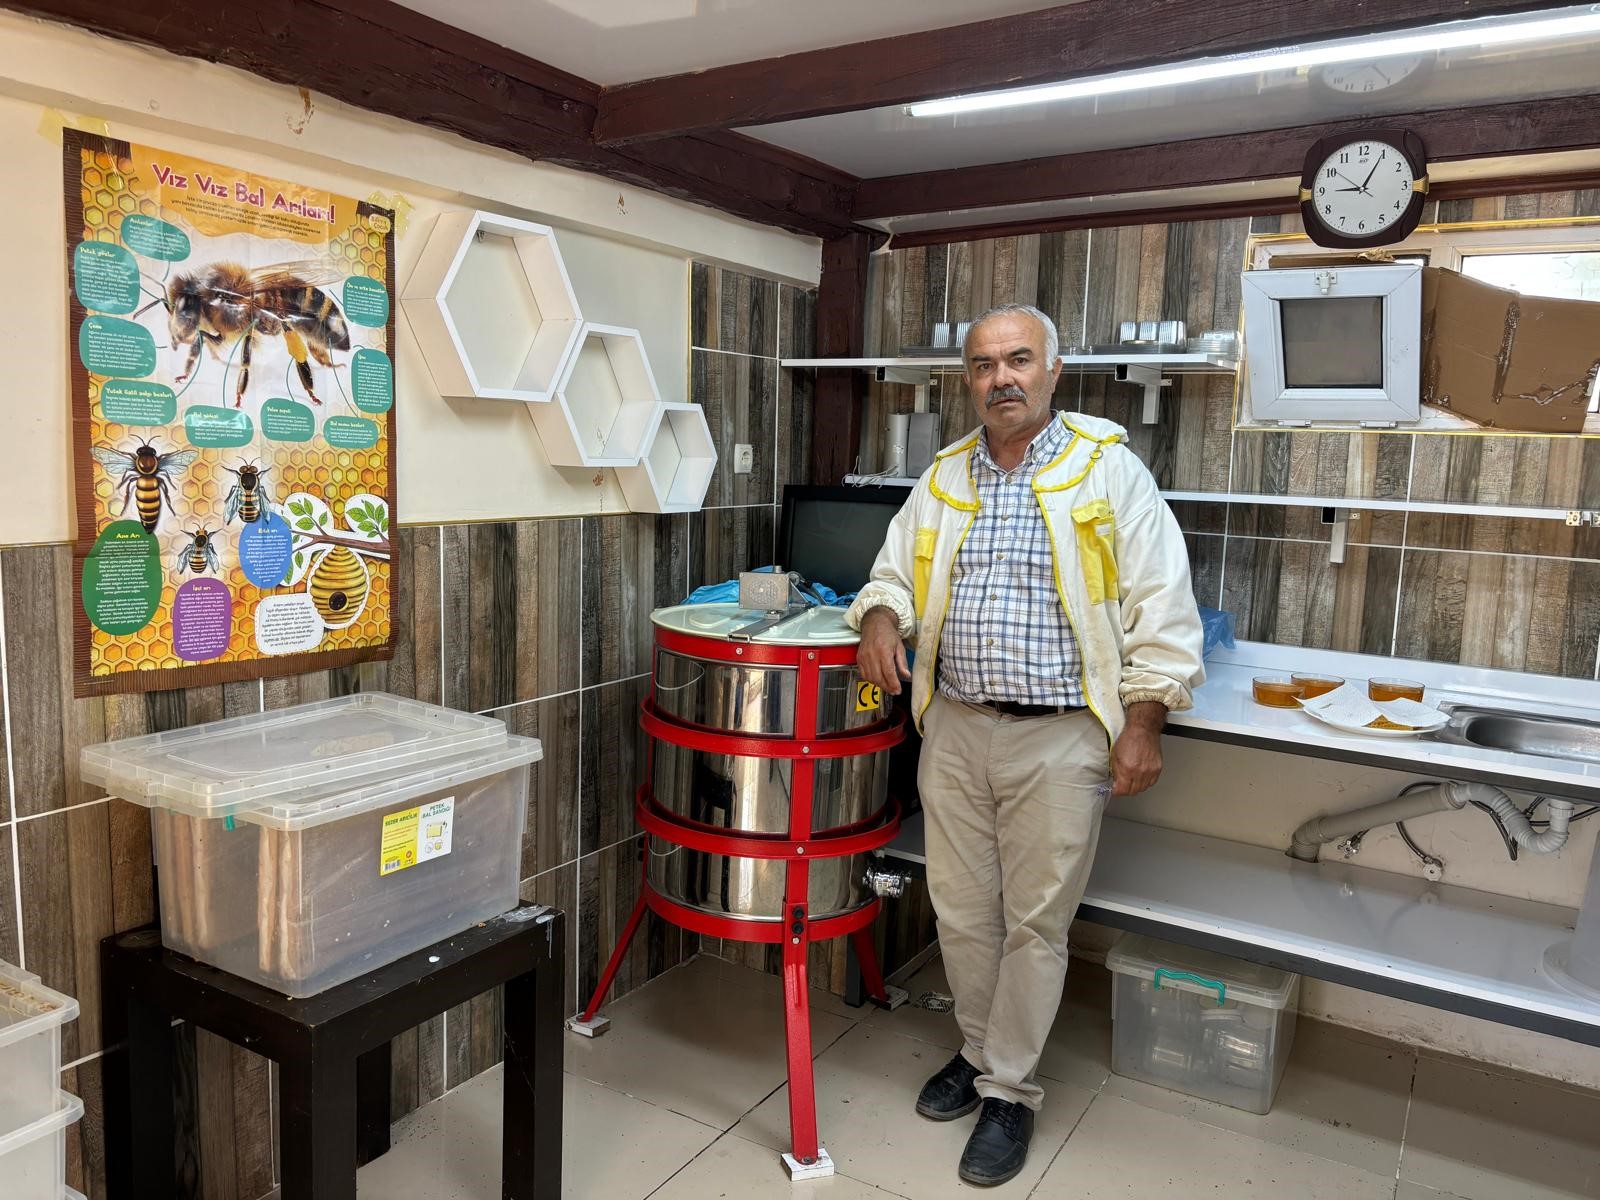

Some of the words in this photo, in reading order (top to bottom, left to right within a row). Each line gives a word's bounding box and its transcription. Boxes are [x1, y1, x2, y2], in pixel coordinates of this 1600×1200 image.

[1359, 145, 1370, 156] 12
[1381, 149, 1386, 160] 1
[1340, 152, 1349, 164] 11
[1395, 162, 1402, 172] 2
[1326, 167, 1337, 178] 10
[152, 164, 188, 189] Vız
[195, 173, 228, 198] Vız
[235, 182, 264, 208] Bal
[1401, 180, 1408, 190] 3
[1319, 187, 1325, 196] 9
[1325, 205, 1331, 215] 8
[1393, 200, 1400, 210] 4
[1340, 216, 1345, 226] 7
[1378, 214, 1385, 224] 5
[1358, 220, 1365, 230] 6
[858, 682, 879, 707] CE
